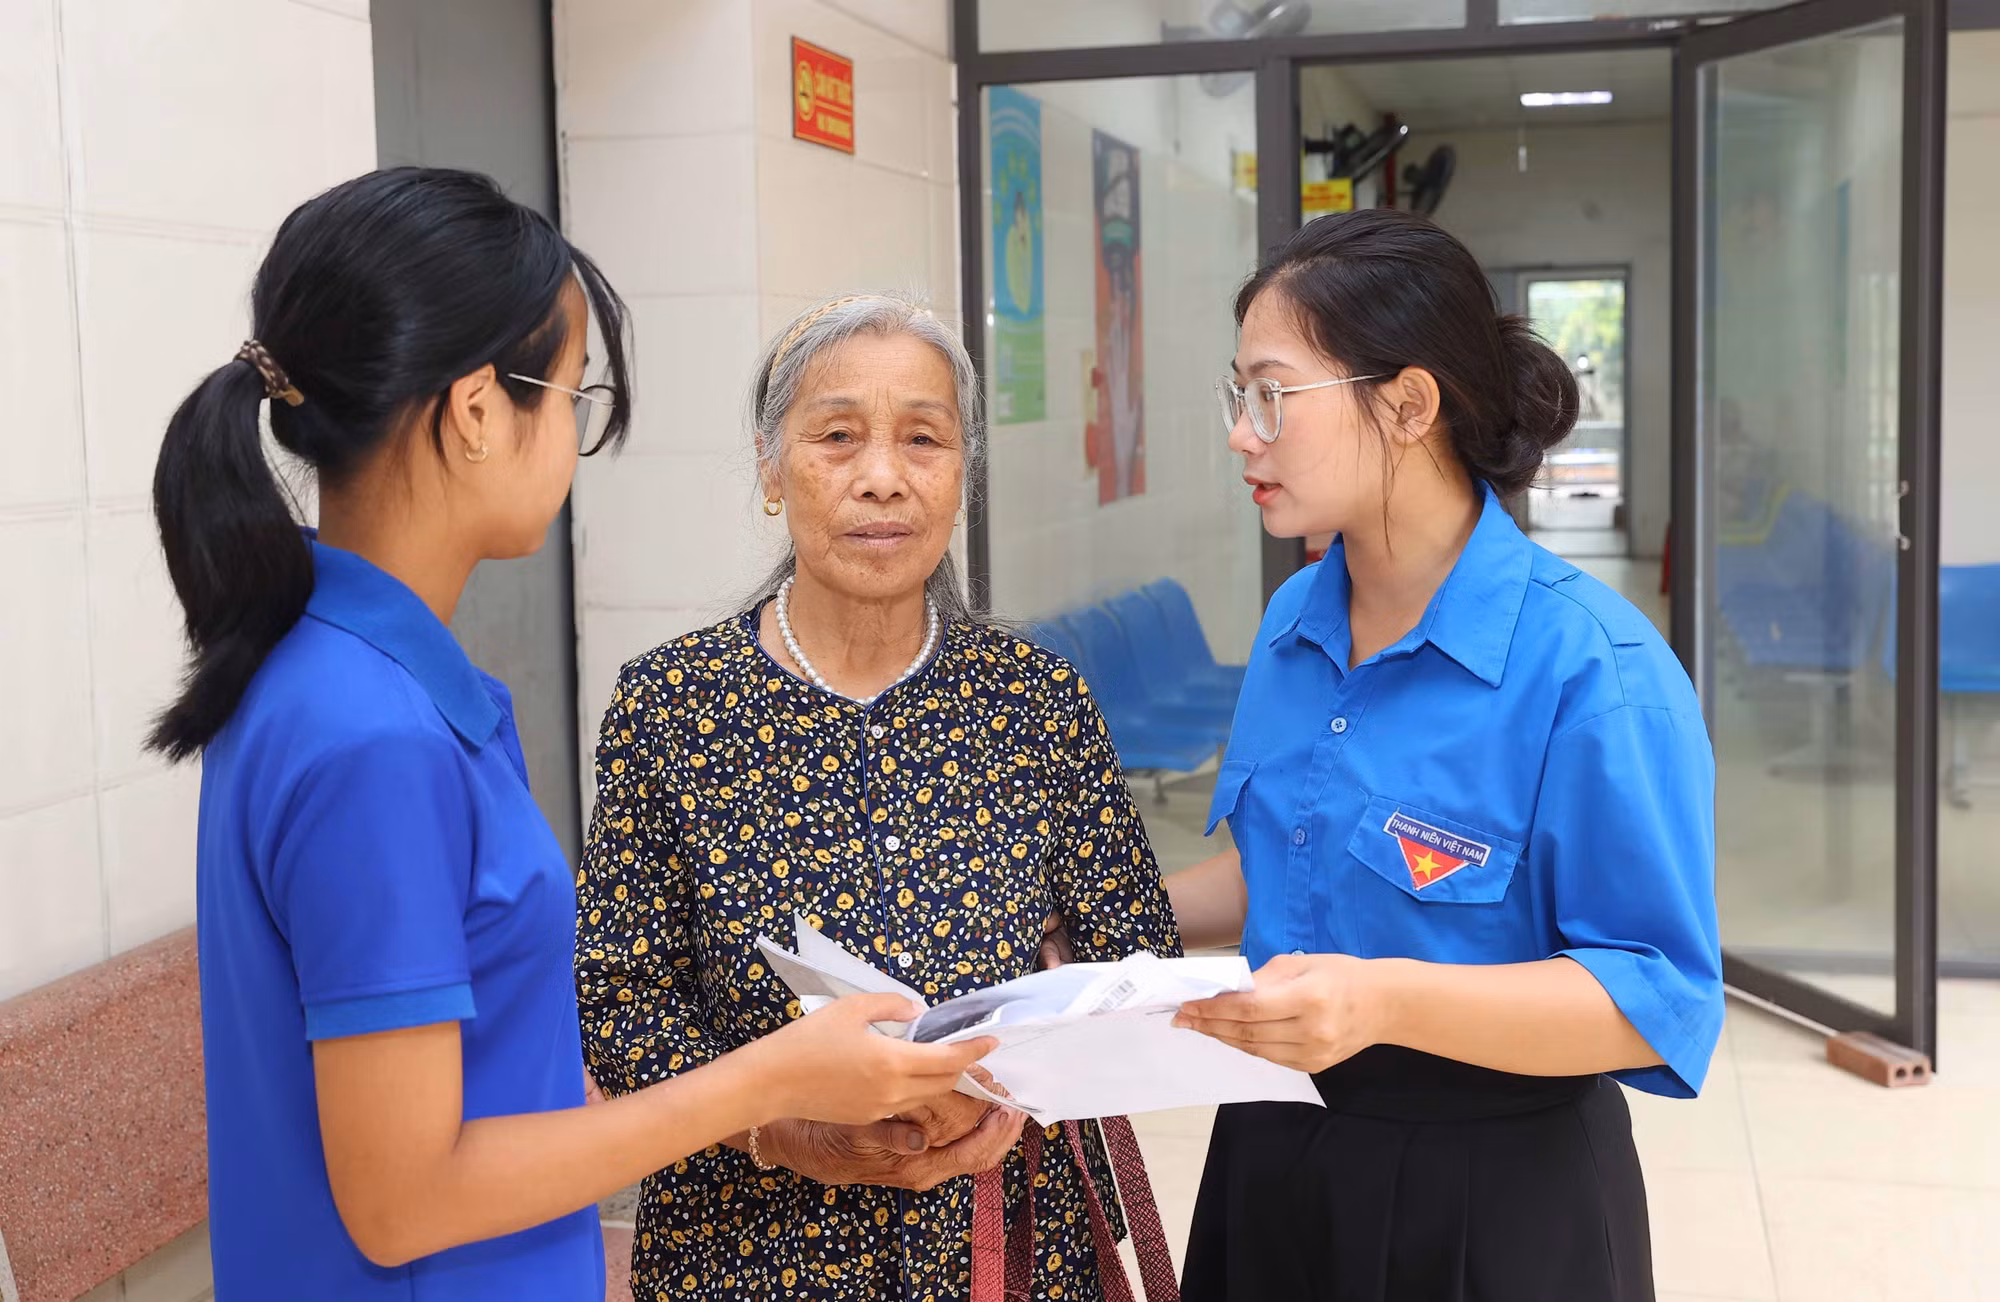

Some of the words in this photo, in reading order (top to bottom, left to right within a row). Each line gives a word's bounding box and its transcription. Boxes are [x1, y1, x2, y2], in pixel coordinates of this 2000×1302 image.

[1391, 819, 1420, 837] THANH
[1420, 830, 1441, 846] NIÊN
[1442, 839, 1462, 854] VIỆT
[1461, 846, 1485, 861] NAM
